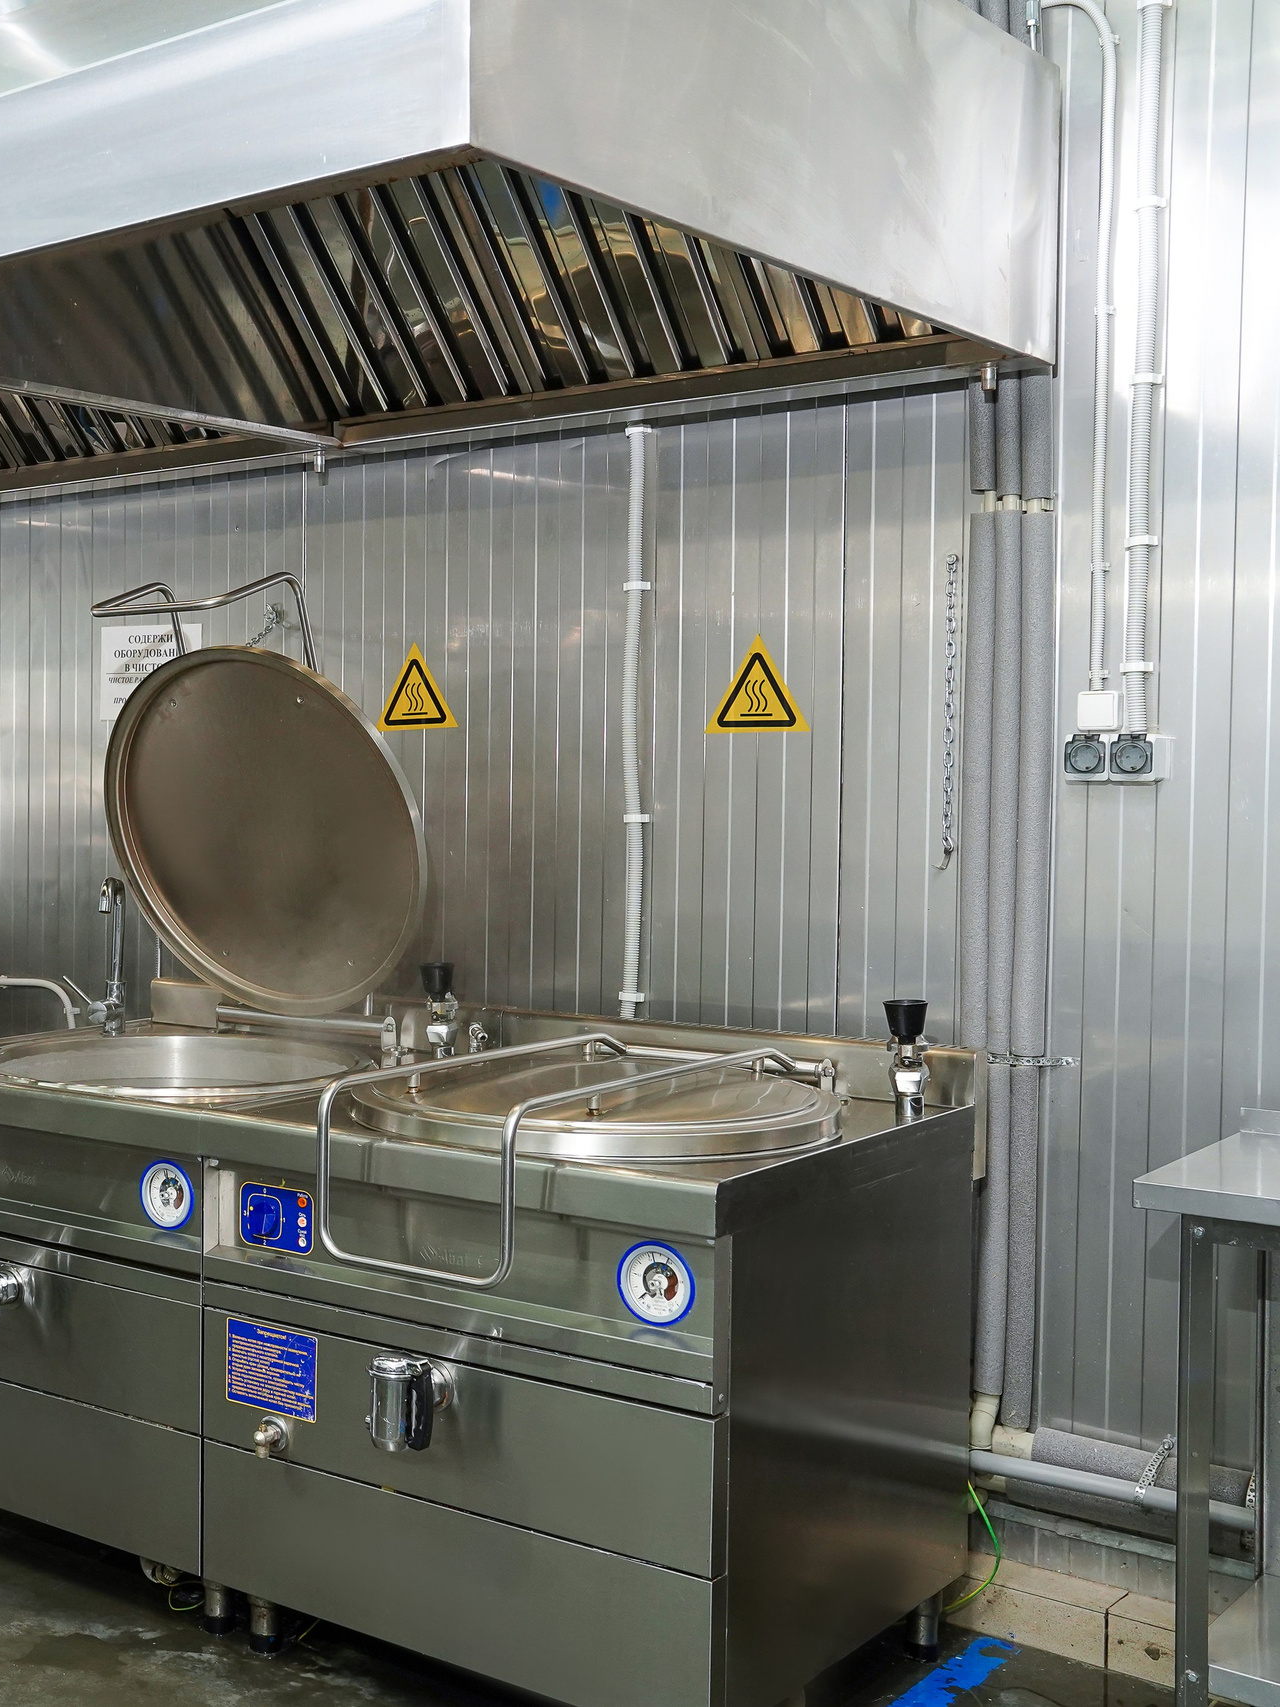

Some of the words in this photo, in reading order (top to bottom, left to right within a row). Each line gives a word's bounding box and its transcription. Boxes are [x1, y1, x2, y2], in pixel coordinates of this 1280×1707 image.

[128, 634, 173, 644] СОДЕРЖИ
[114, 648, 187, 659] ОБОРУДОВАН
[124, 663, 131, 672] В
